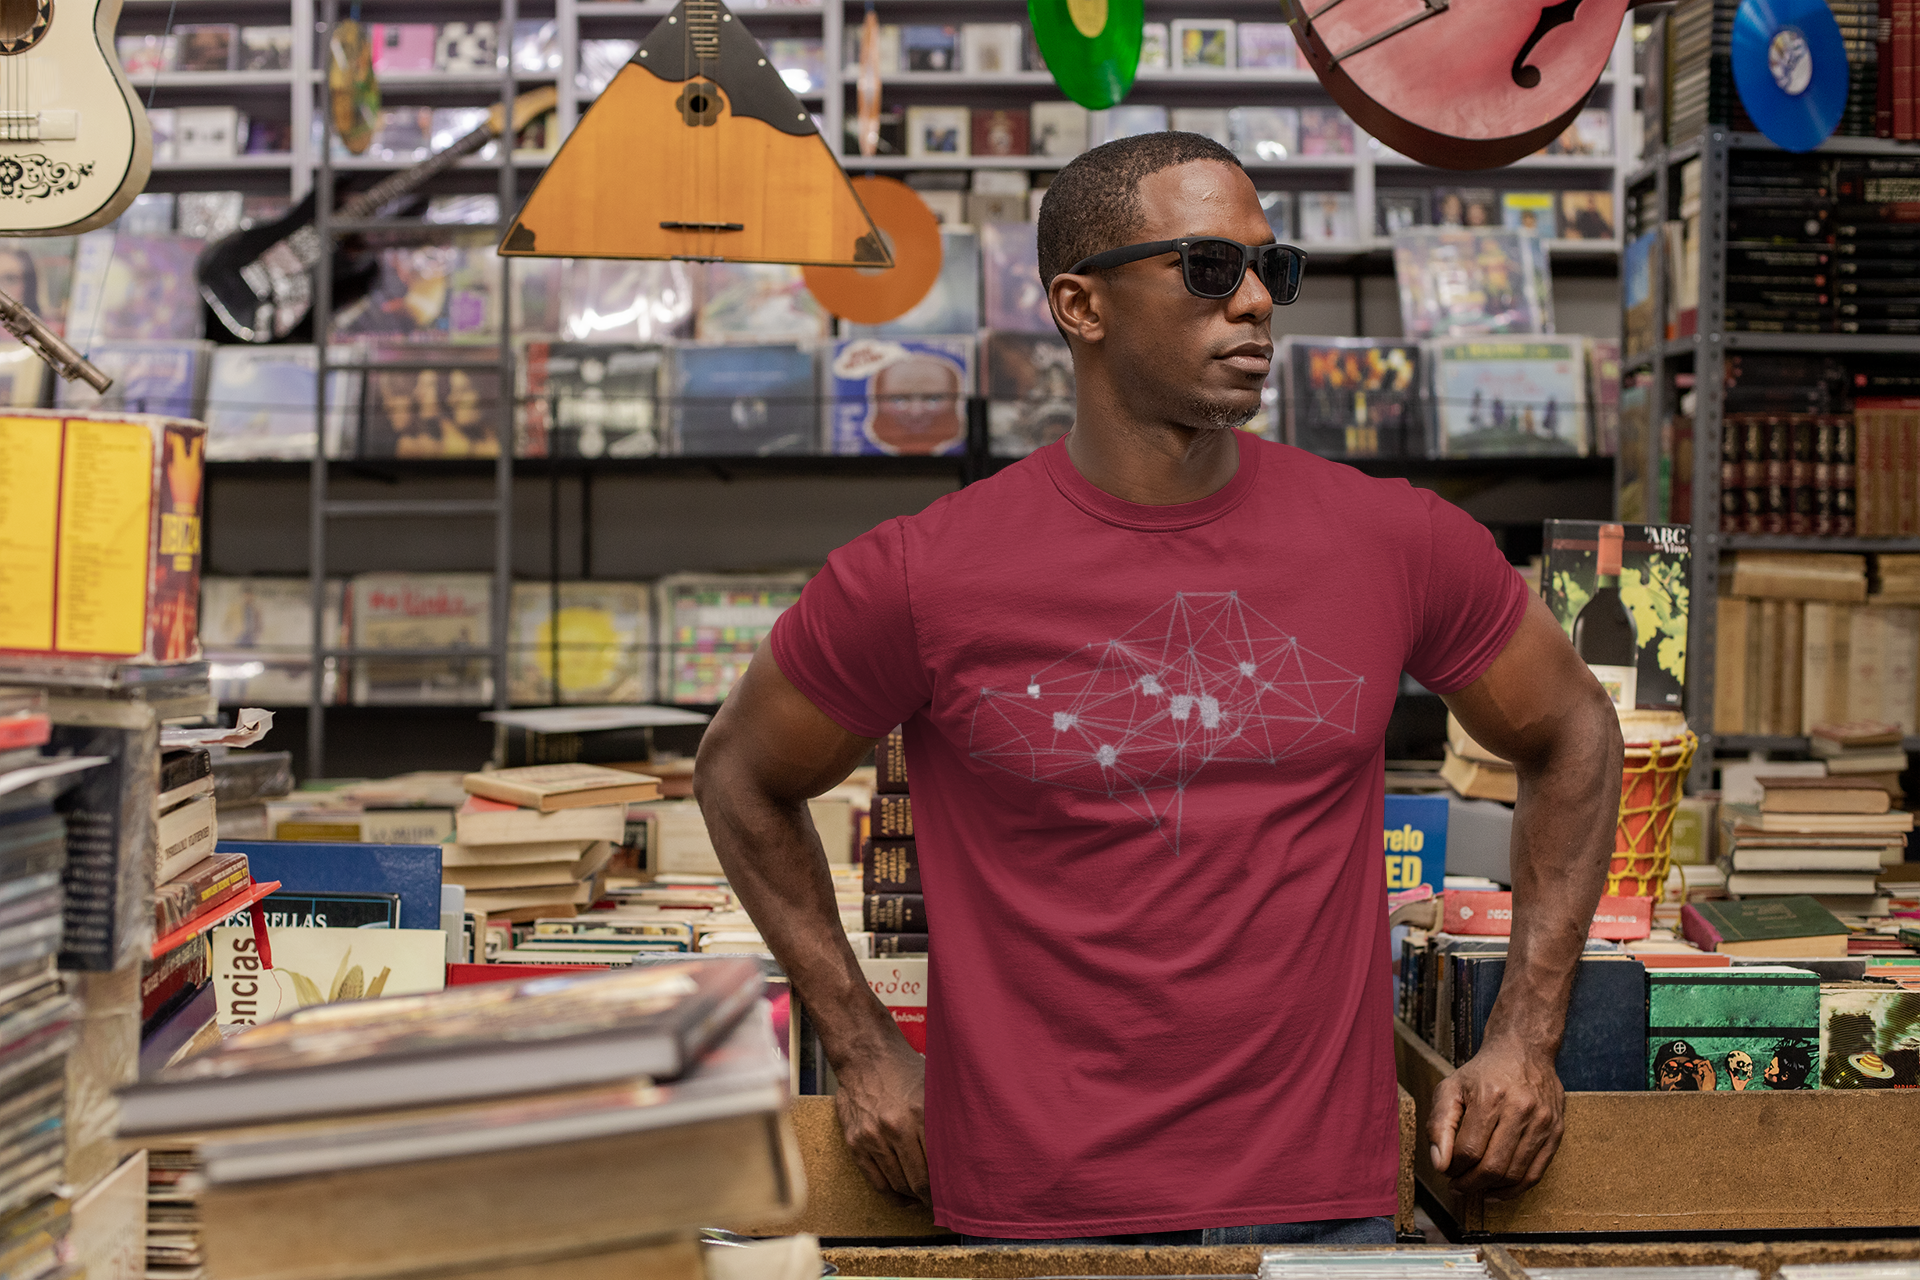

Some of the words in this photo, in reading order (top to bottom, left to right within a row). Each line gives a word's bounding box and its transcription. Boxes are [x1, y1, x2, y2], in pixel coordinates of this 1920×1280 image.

[1647, 527, 1686, 545] ABC
[1663, 542, 1689, 554] Vino
[881, 797, 889, 835] AMADO
[873, 847, 882, 884] AMADO
[1386, 855, 1422, 889] ED
